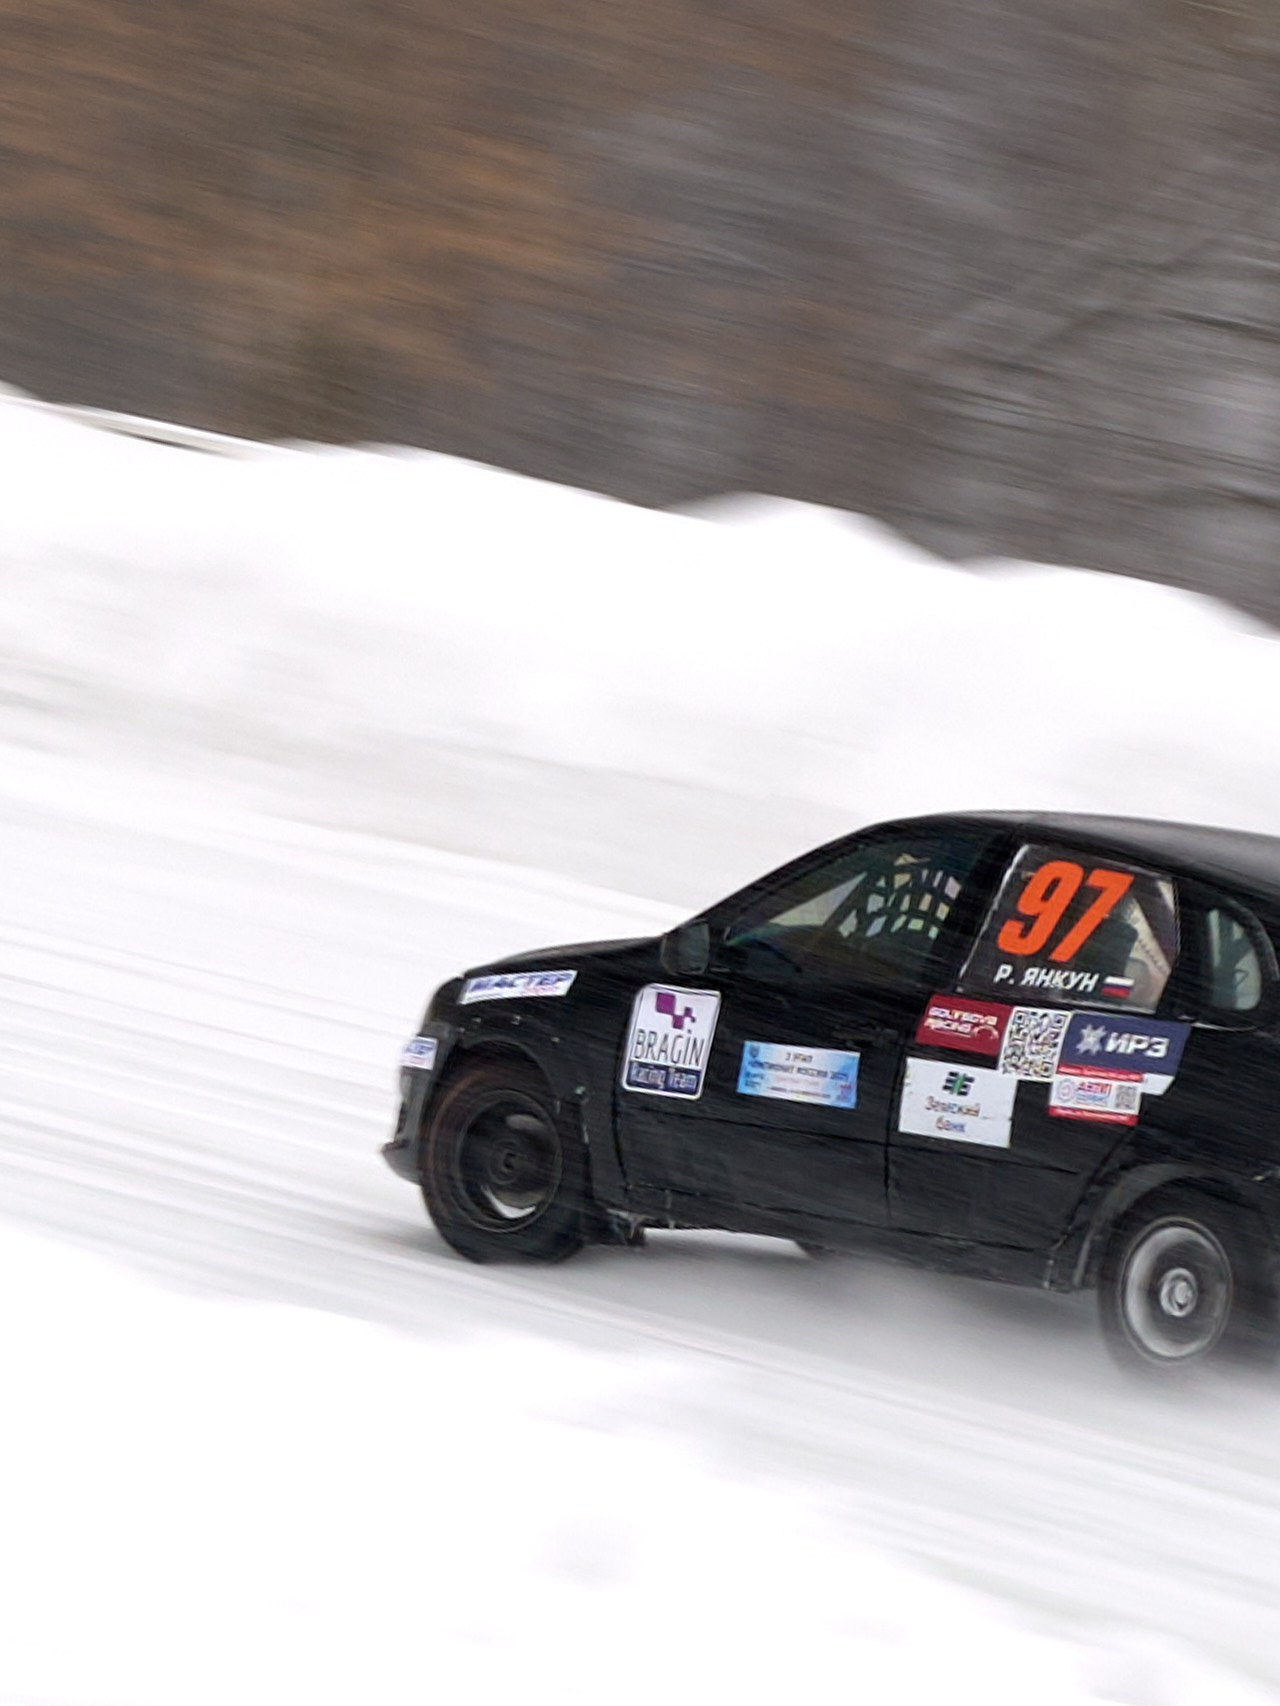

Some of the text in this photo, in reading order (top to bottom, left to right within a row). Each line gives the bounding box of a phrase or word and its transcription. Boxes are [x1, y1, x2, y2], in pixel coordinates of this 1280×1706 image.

[997, 860, 1135, 962] 97
[993, 964, 1099, 993] Р. ЯНКУН
[1105, 1031, 1170, 1059] ИРЗ
